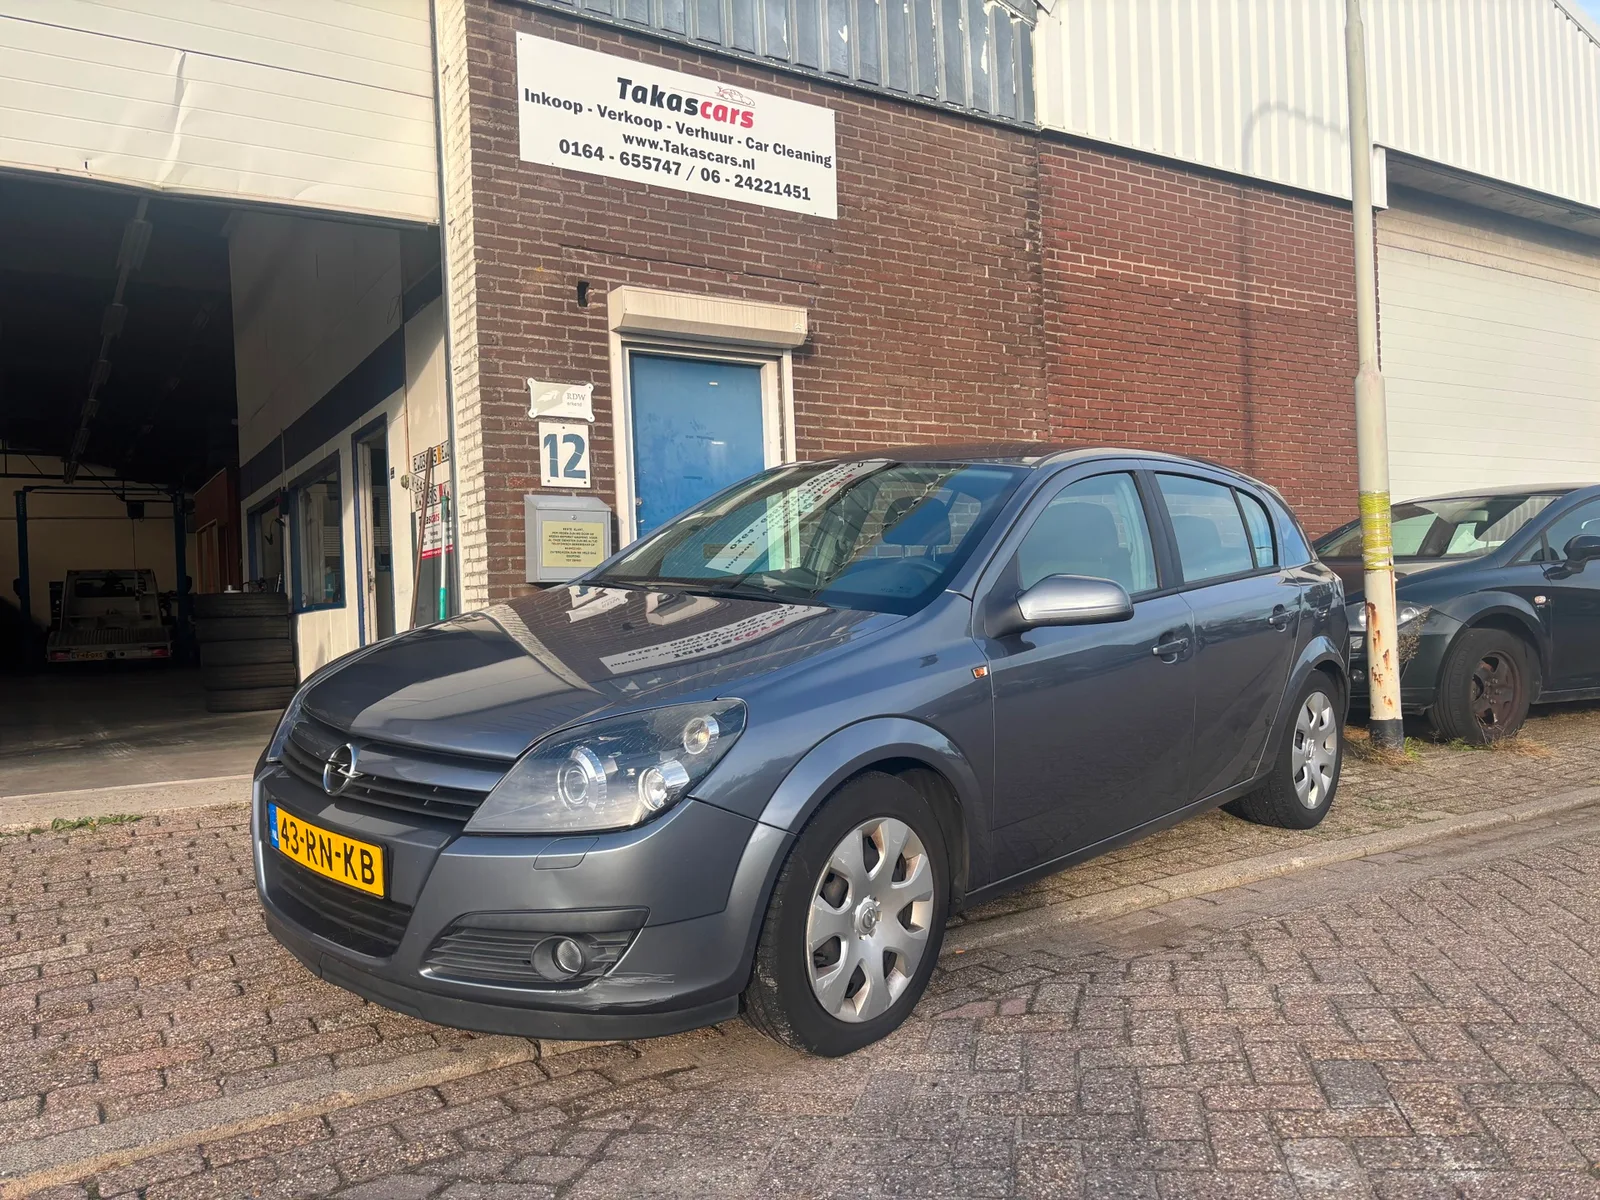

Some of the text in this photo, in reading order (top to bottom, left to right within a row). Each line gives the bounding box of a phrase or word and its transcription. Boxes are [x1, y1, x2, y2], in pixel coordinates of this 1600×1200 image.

[524, 88, 583, 115] Inkoop
[597, 104, 663, 132] Verkoop
[675, 121, 734, 145] Verhuur
[746, 137, 769, 152] Car
[773, 143, 832, 168] Cleaning
[617, 77, 754, 128] Takascars
[559, 139, 605, 161] 0164
[619, 152, 682, 176] 655747
[700, 167, 721, 183] 06
[734, 174, 811, 201] 24221451
[622, 134, 755, 170] www.Takascars.nl
[566, 392, 586, 401] RDW
[544, 433, 587, 479] 12
[281, 817, 375, 885] 43-RN-KB
